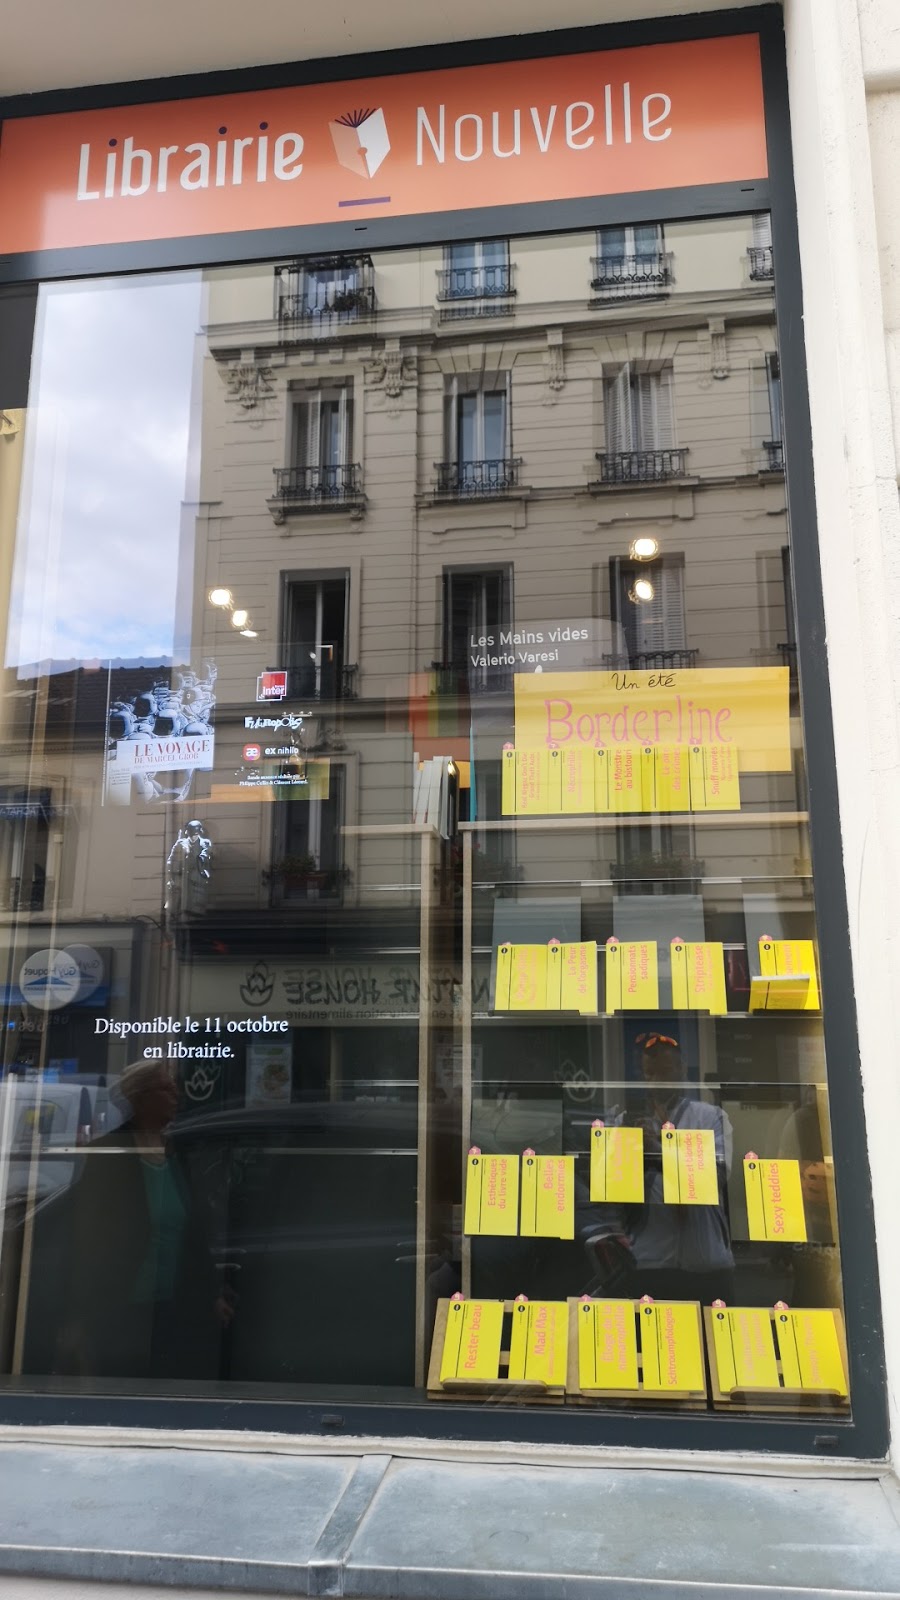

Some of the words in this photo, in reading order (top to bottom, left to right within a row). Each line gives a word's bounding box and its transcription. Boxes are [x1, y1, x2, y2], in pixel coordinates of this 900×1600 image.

[76, 121, 304, 202] Librairie
[415, 81, 673, 166] Nouvelle
[470, 634, 495, 648] Les
[500, 629, 544, 646] Mains
[549, 627, 589, 643] vides
[470, 653, 515, 668] Valerio
[519, 650, 559, 664] Varesi
[263, 686, 285, 696] inter
[611, 673, 640, 690] Un
[648, 673, 676, 688] été
[544, 695, 733, 746] Borderline
[134, 744, 153, 757] LE
[157, 740, 210, 754] VOYAGE
[147, 755, 175, 763] MARCEL
[278, 747, 299, 755] nihilo
[710, 747, 718, 772] movies
[614, 750, 622, 780] Monstre
[624, 749, 632, 777] bistouri
[662, 766, 670, 775] Le
[672, 748, 680, 773] crimes
[626, 780, 632, 789] au
[672, 777, 680, 790] des
[710, 775, 720, 794] Snuff
[568, 946, 576, 964] Peur
[639, 944, 649, 980] sadiques
[628, 945, 637, 993] Pensionnats
[694, 946, 706, 992] Striptease
[577, 983, 586, 993] de
[94, 1016, 181, 1038] Disponible
[185, 1016, 199, 1033] le
[204, 1018, 221, 1033] 11
[226, 1015, 289, 1033] octobre
[143, 1046, 163, 1058] en
[168, 1042, 235, 1059] librairie.
[683, 1133, 692, 1162] blondes
[696, 1133, 705, 1170] rousseurs
[499, 1158, 507, 1175] vide
[543, 1160, 553, 1189] Belles
[684, 1164, 692, 1172] et
[488, 1159, 498, 1206] Esthétiques
[555, 1159, 565, 1211] endormies
[768, 1163, 781, 1203] teddies
[498, 1199, 506, 1209] du
[772, 1206, 785, 1234] Sexy
[468, 1304, 482, 1331] beau
[535, 1306, 547, 1329] Max
[463, 1333, 480, 1369] Rester
[534, 1331, 546, 1355] Mad
